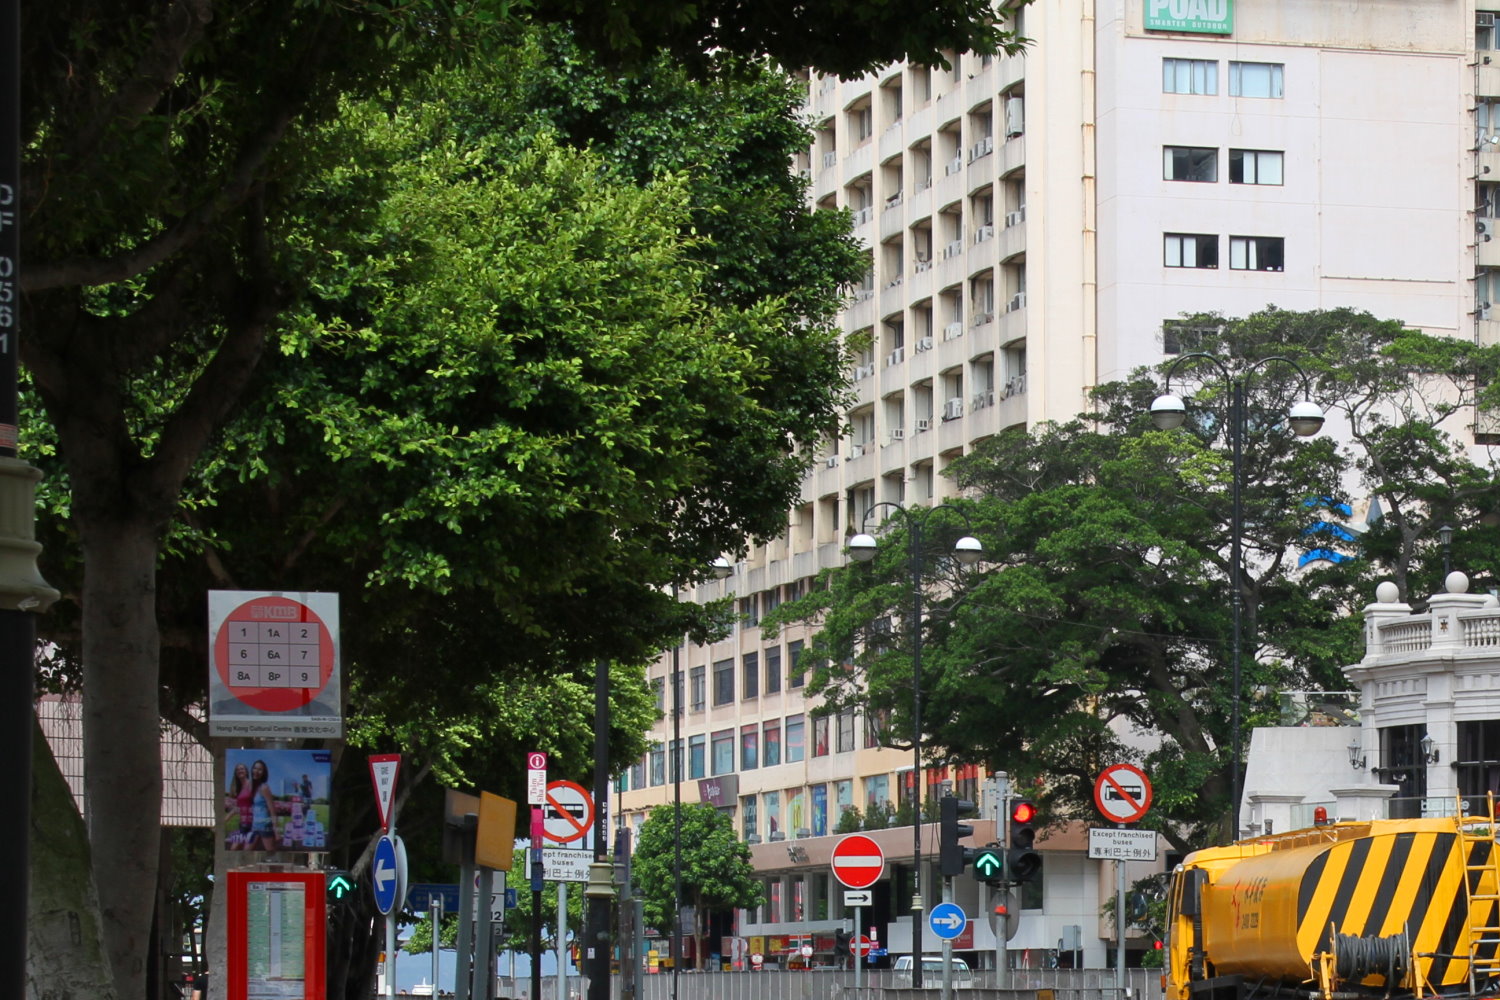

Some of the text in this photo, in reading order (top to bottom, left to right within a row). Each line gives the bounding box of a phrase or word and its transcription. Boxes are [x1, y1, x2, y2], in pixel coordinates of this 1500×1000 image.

[241, 628, 308, 638] 1 1A 2
[240, 650, 307, 660] 6 6A 7
[238, 672, 308, 682] 8A 8P 9
[1092, 830, 1153, 839] Except franchised
